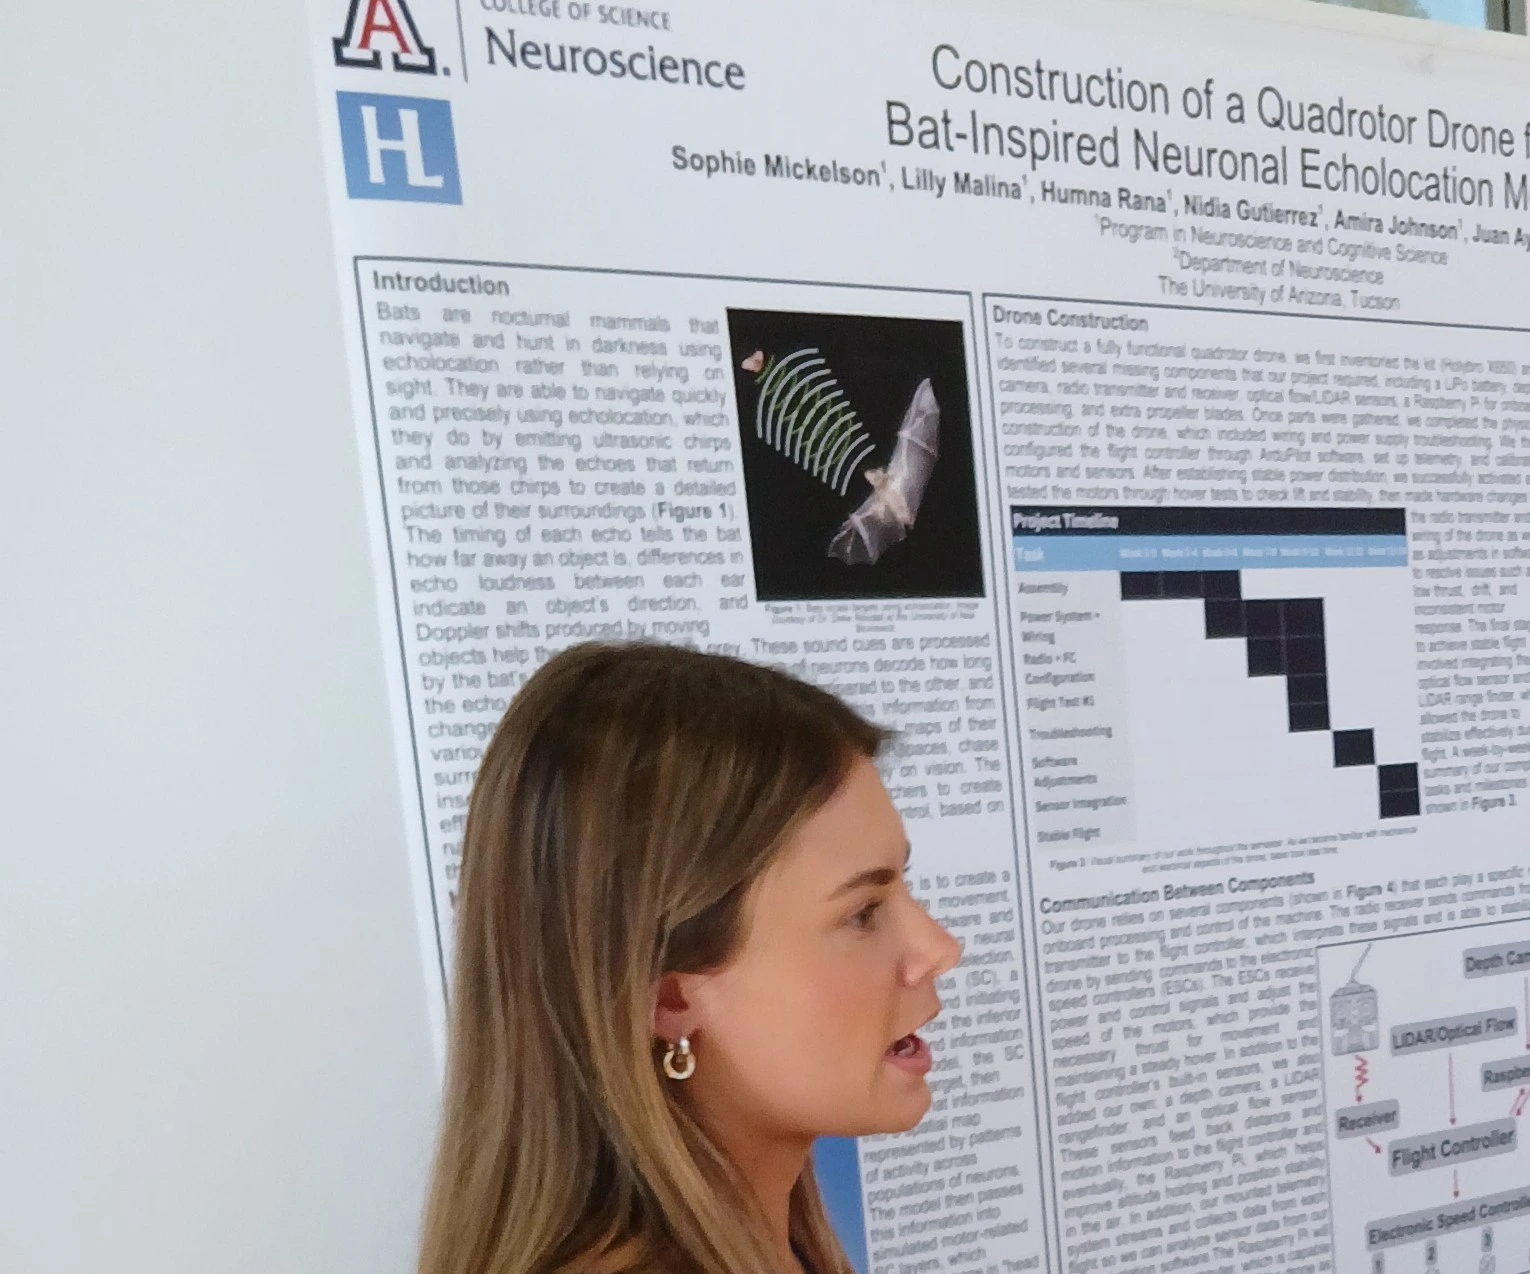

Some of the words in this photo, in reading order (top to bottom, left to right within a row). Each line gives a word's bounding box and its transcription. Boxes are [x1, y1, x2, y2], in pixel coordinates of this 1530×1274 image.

[567, 2, 590, 21] OF
[598, 5, 671, 31] SCIENCE
[485, 27, 746, 90] Neuroscience
[931, 42, 1170, 114] Construction
[1182, 78, 1214, 121] of
[1226, 92, 1246, 124] a
[1257, 86, 1418, 145] Quadrotor
[1428, 108, 1515, 158] Drone
[885, 99, 1120, 170] Bat-Inspired
[1133, 128, 1288, 185] Neuronal
[1299, 148, 1494, 208] Echolocation
[672, 145, 756, 178] Sophie
[901, 166, 946, 199] Lilly
[1041, 180, 1111, 208] Humna
[1183, 194, 1231, 220] Nidia
[1334, 210, 1383, 233] Amira
[1472, 224, 1509, 245] Juan
[1173, 226, 1186, 243] in
[1190, 226, 1292, 252] Neuroscience
[1297, 236, 1323, 255] and
[1327, 237, 1391, 261] Cognitive
[1395, 243, 1448, 266] Science
[373, 269, 510, 297] Introduction
[1271, 258, 1286, 277] of
[1288, 260, 1384, 285] Neuroscience
[1157, 274, 1187, 297] The
[1192, 277, 1265, 305] University
[1270, 284, 1284, 301] of
[1350, 289, 1400, 311] Tucson
[993, 305, 1043, 326] Drone
[1047, 308, 1149, 332] Construction
[1012, 512, 1062, 533] Project
[1039, 889, 1160, 914] Communication
[1163, 881, 1225, 901] Between
[1227, 871, 1316, 893] Components
[1464, 953, 1504, 973] Depth
[1337, 1108, 1398, 1132] Receiver
[1391, 1142, 1437, 1169] Flight
[1440, 1128, 1516, 1159] Controller
[1368, 1218, 1434, 1246] Electronic
[1436, 1206, 1476, 1230] Speed
